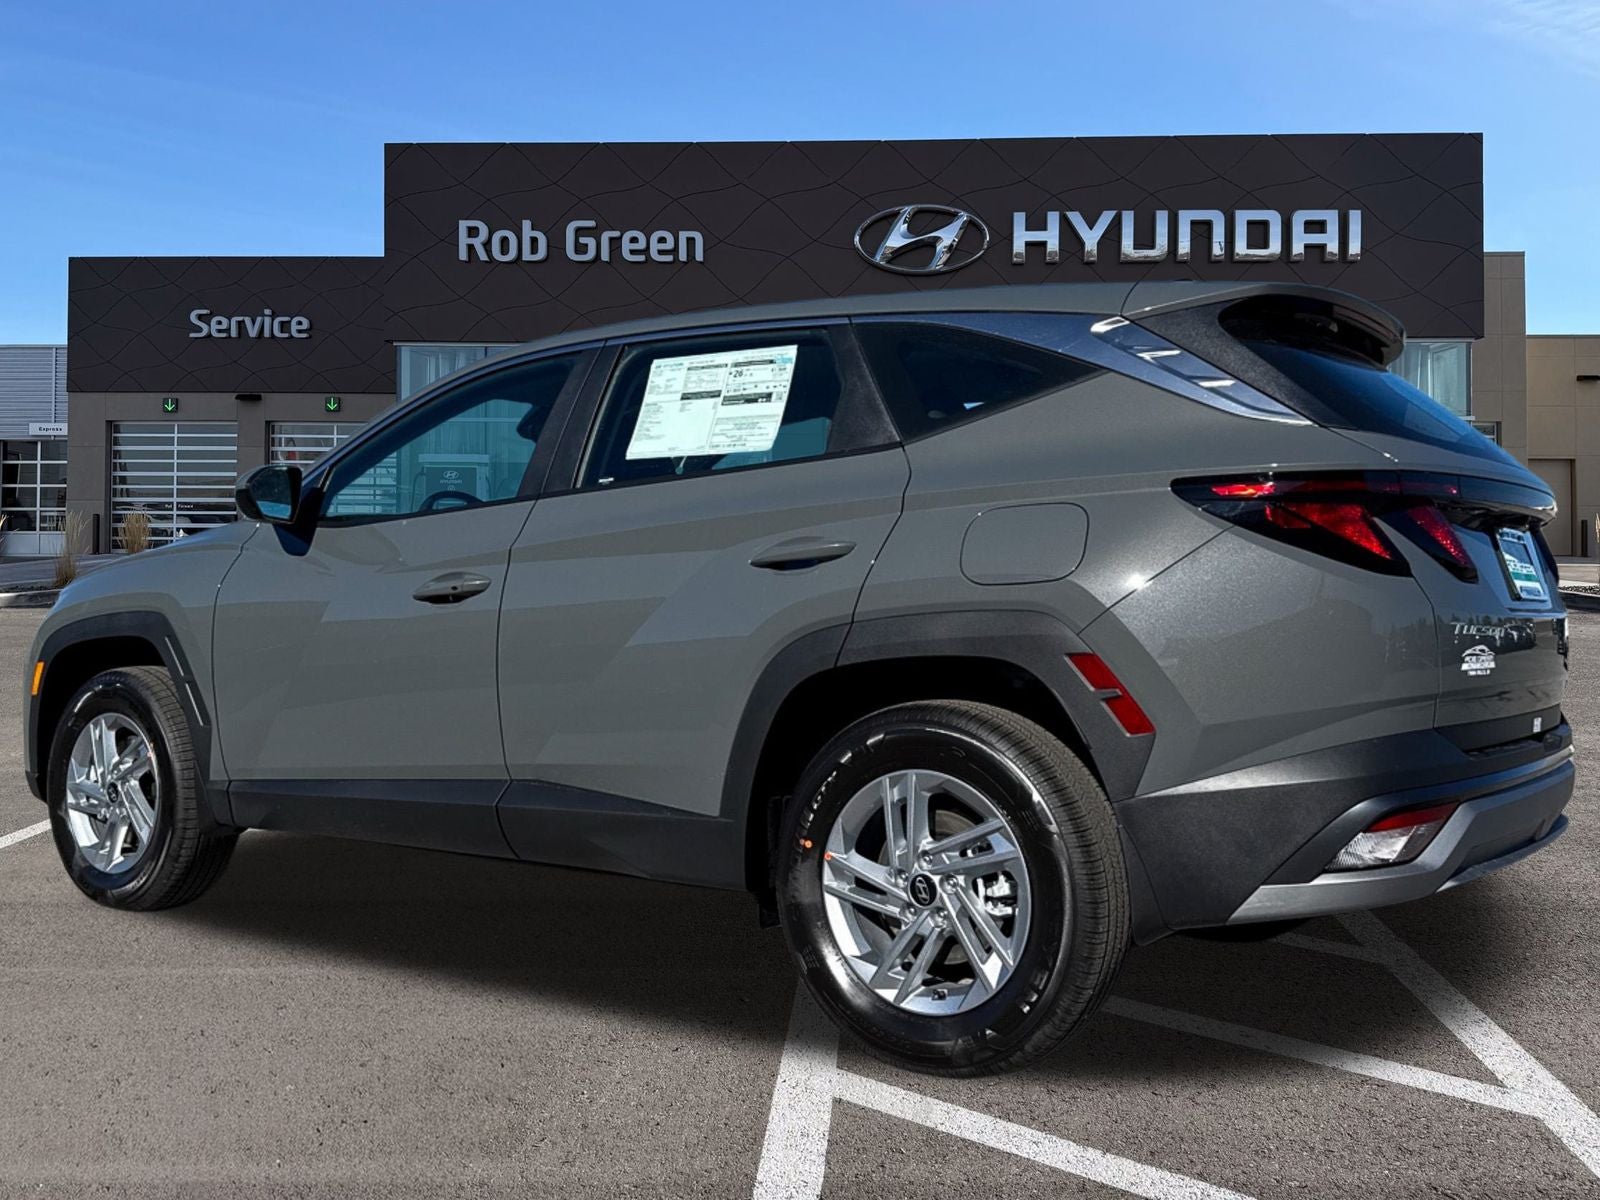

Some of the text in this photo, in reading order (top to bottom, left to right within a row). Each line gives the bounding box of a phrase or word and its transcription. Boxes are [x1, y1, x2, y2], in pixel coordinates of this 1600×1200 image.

[457, 219, 704, 263] Rob Green
[1011, 209, 1362, 264] HYUNDAI
[188, 308, 310, 338] Service
